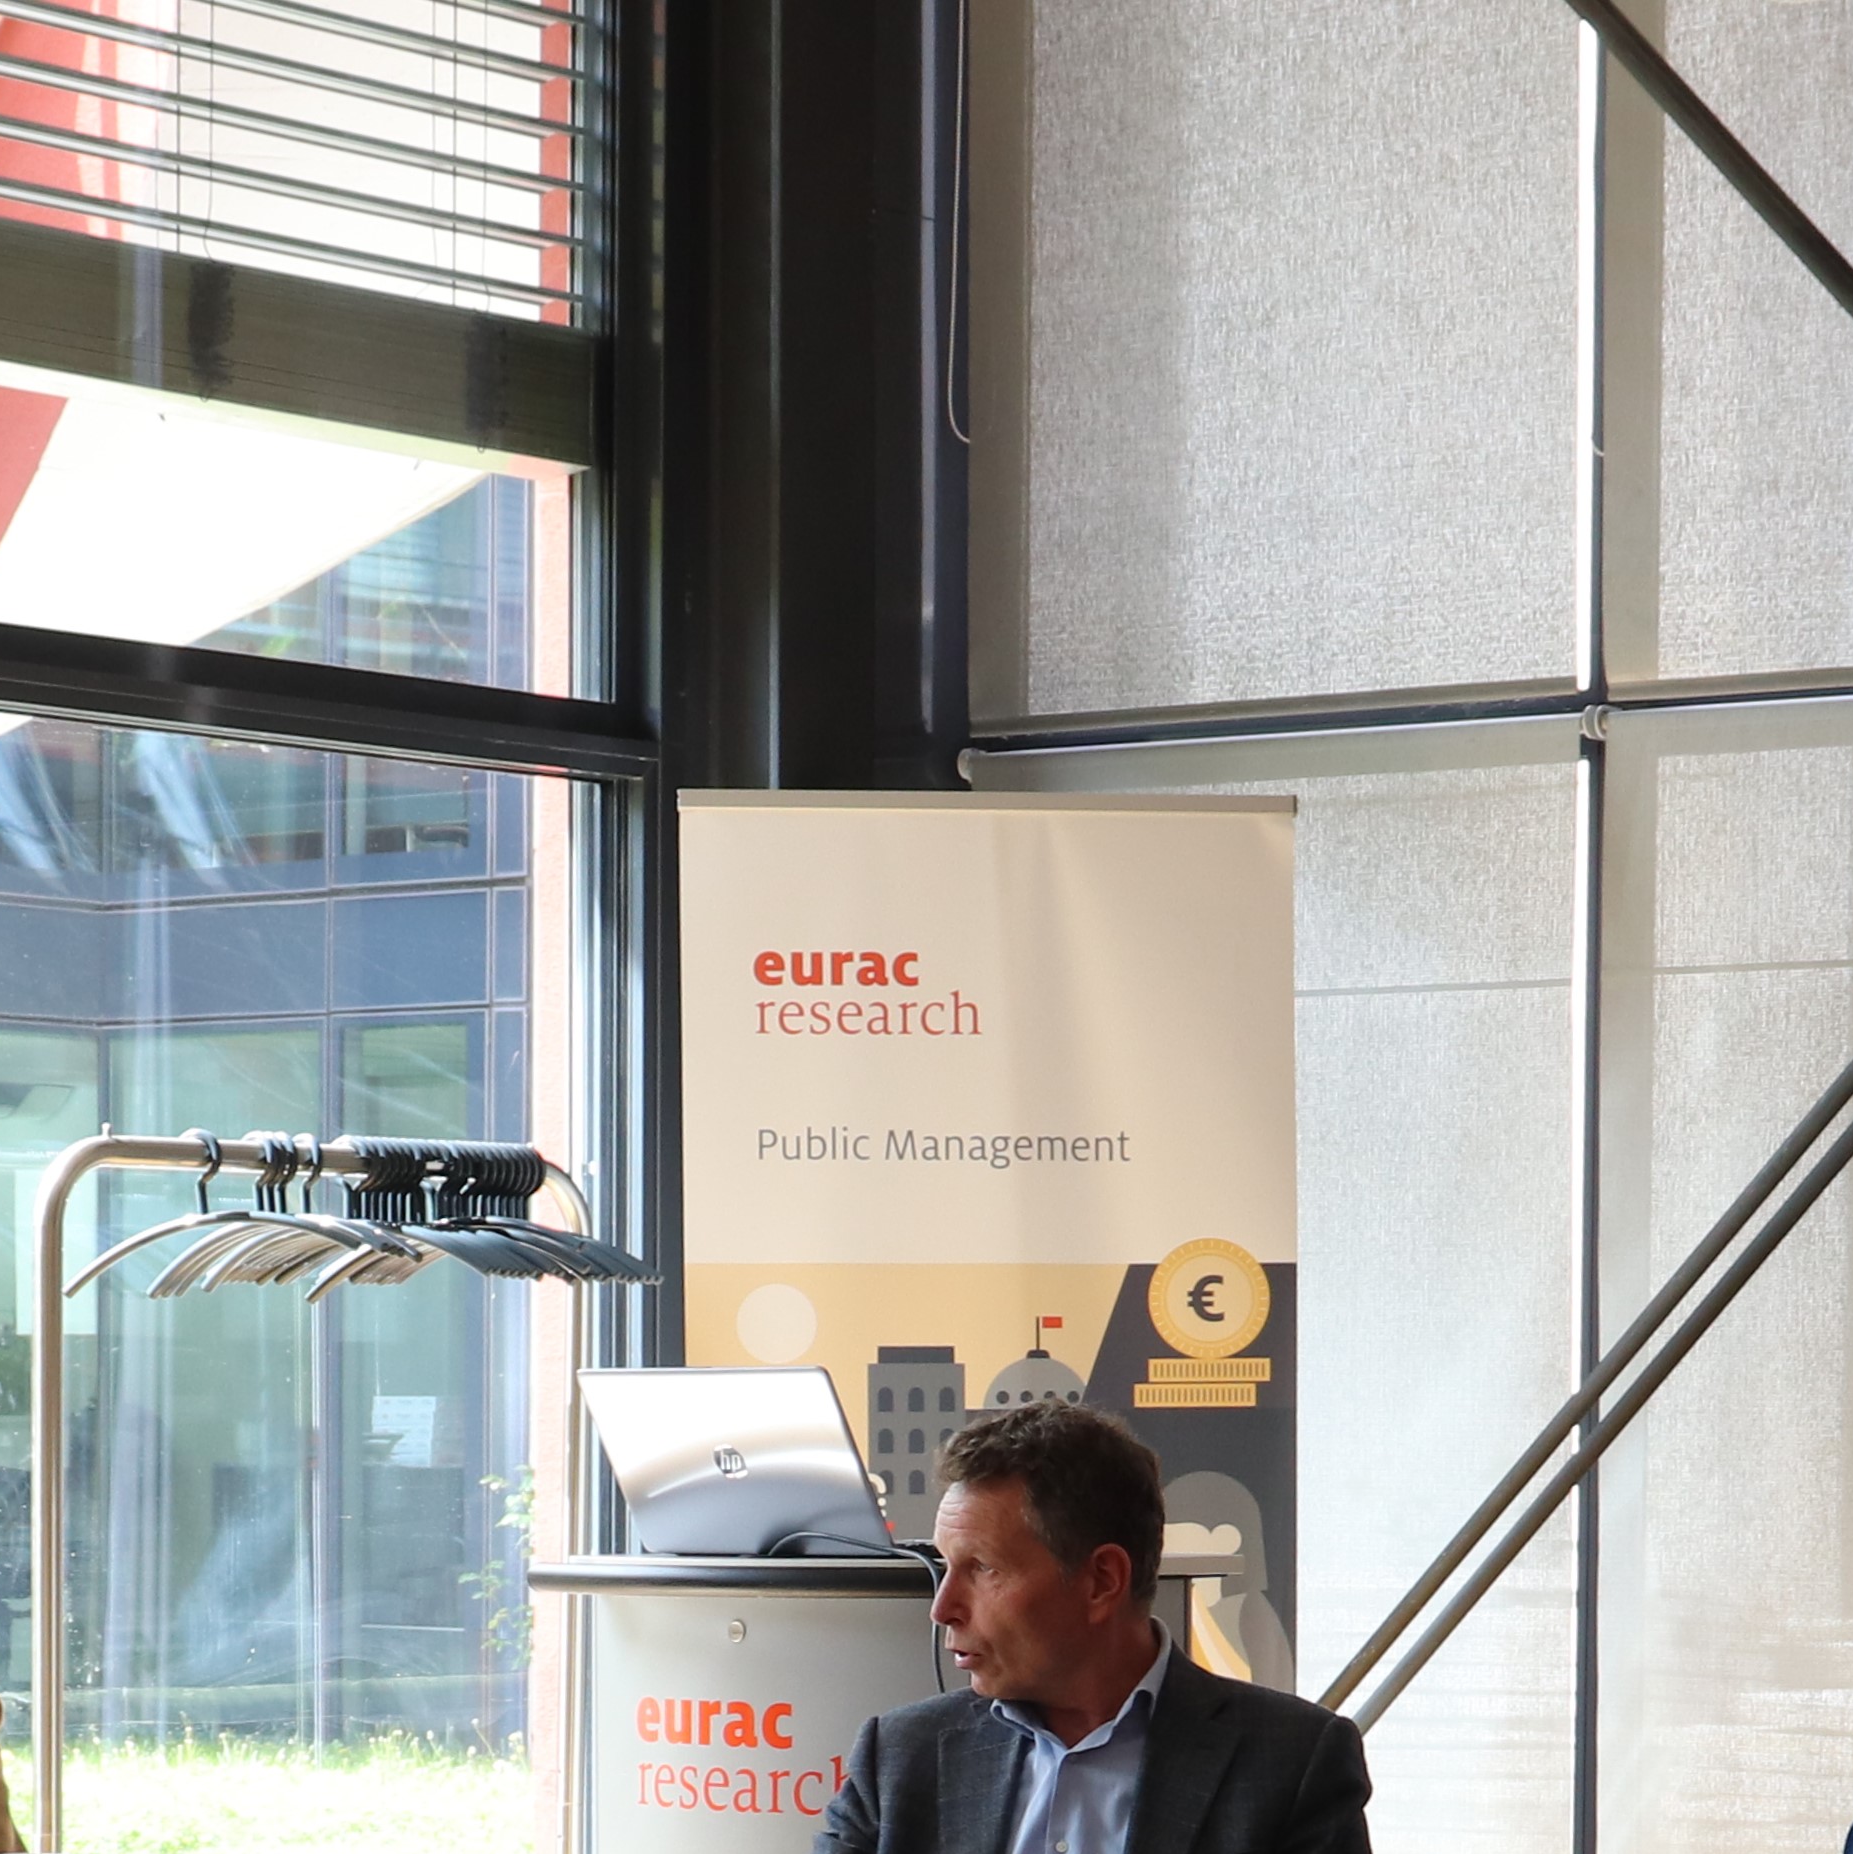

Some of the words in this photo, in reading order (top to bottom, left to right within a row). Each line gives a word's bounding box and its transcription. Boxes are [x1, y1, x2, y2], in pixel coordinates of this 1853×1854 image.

[753, 950, 920, 987] eurac
[755, 991, 982, 1036] research
[757, 1126, 871, 1161] Public
[885, 1129, 1131, 1170] Management
[637, 1697, 794, 1749] eurac
